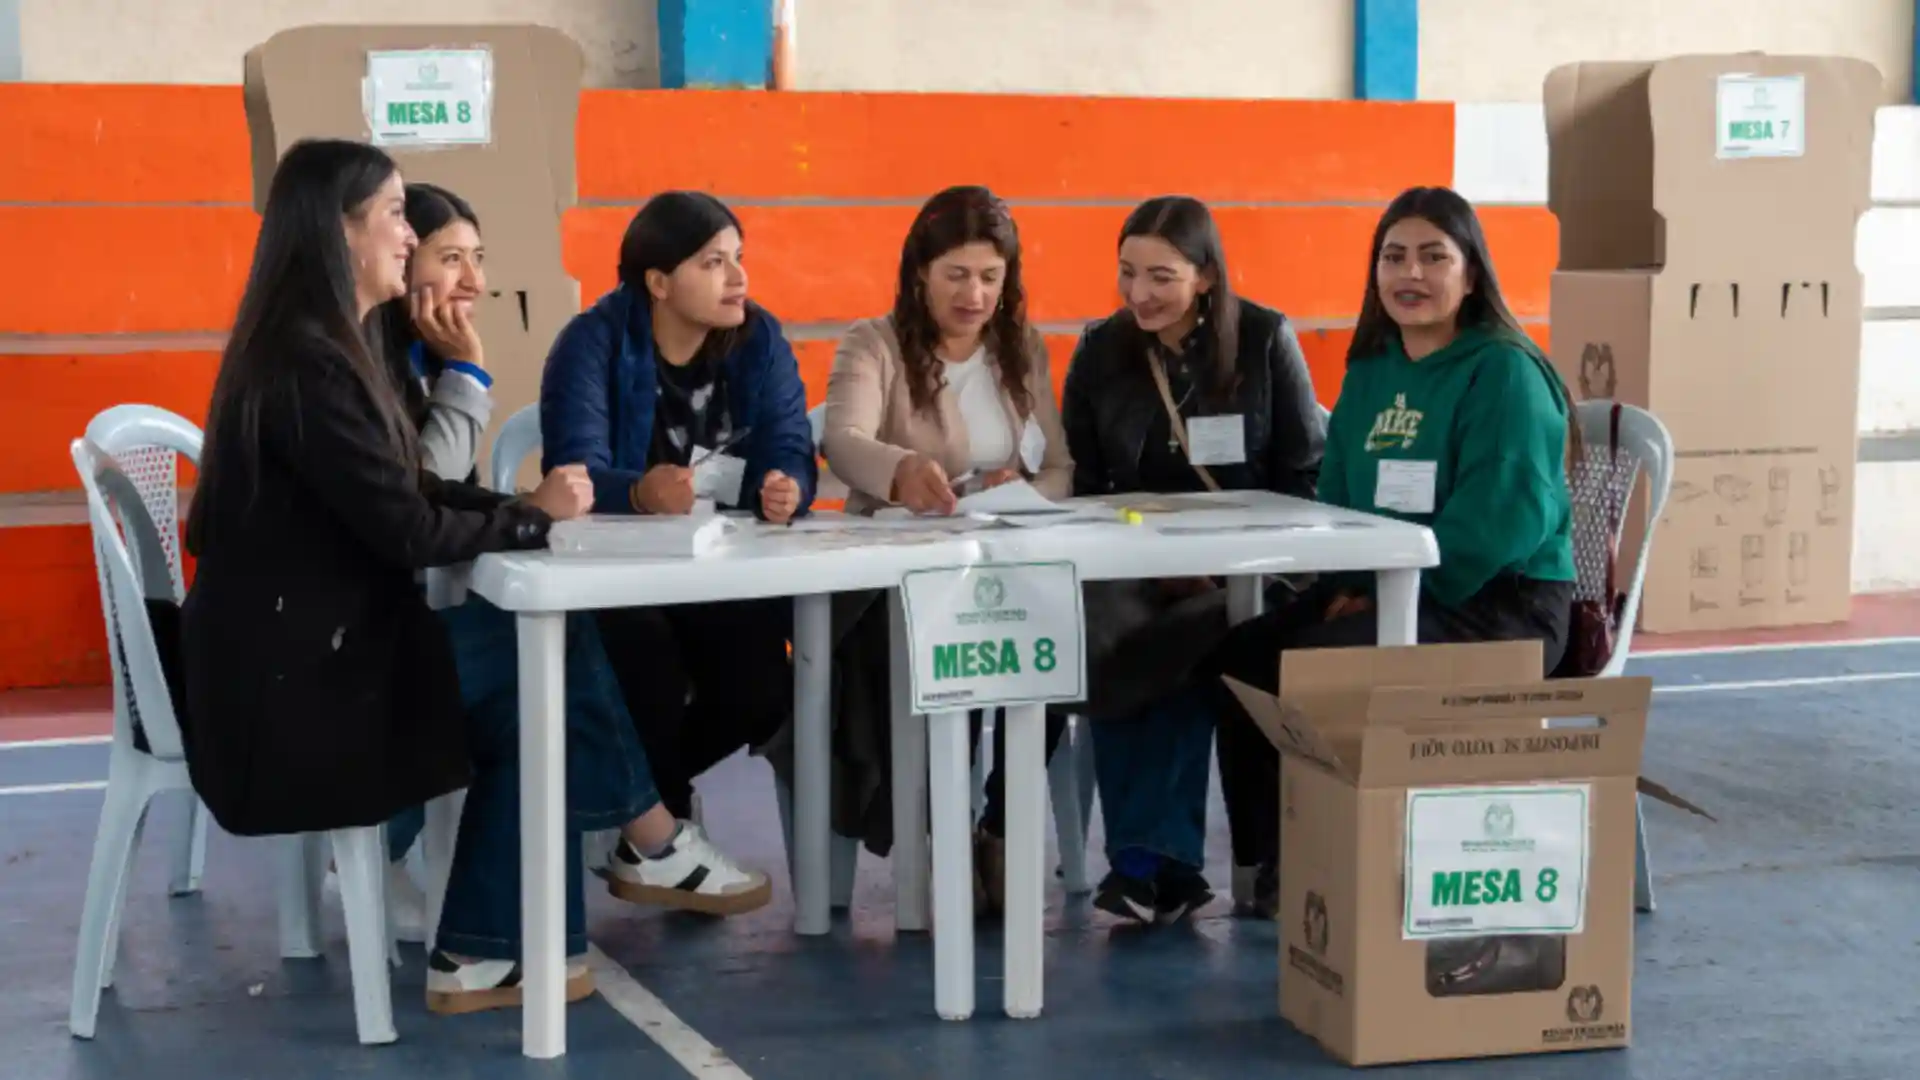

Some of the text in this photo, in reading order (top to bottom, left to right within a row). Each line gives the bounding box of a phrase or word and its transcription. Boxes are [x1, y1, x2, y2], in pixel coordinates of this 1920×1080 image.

[387, 101, 471, 125] MESA 8
[1729, 119, 1790, 141] MESA 7
[933, 637, 1057, 681] MESA 8
[1451, 740, 1495, 756] VOTO
[1431, 867, 1560, 907] MESA 8
